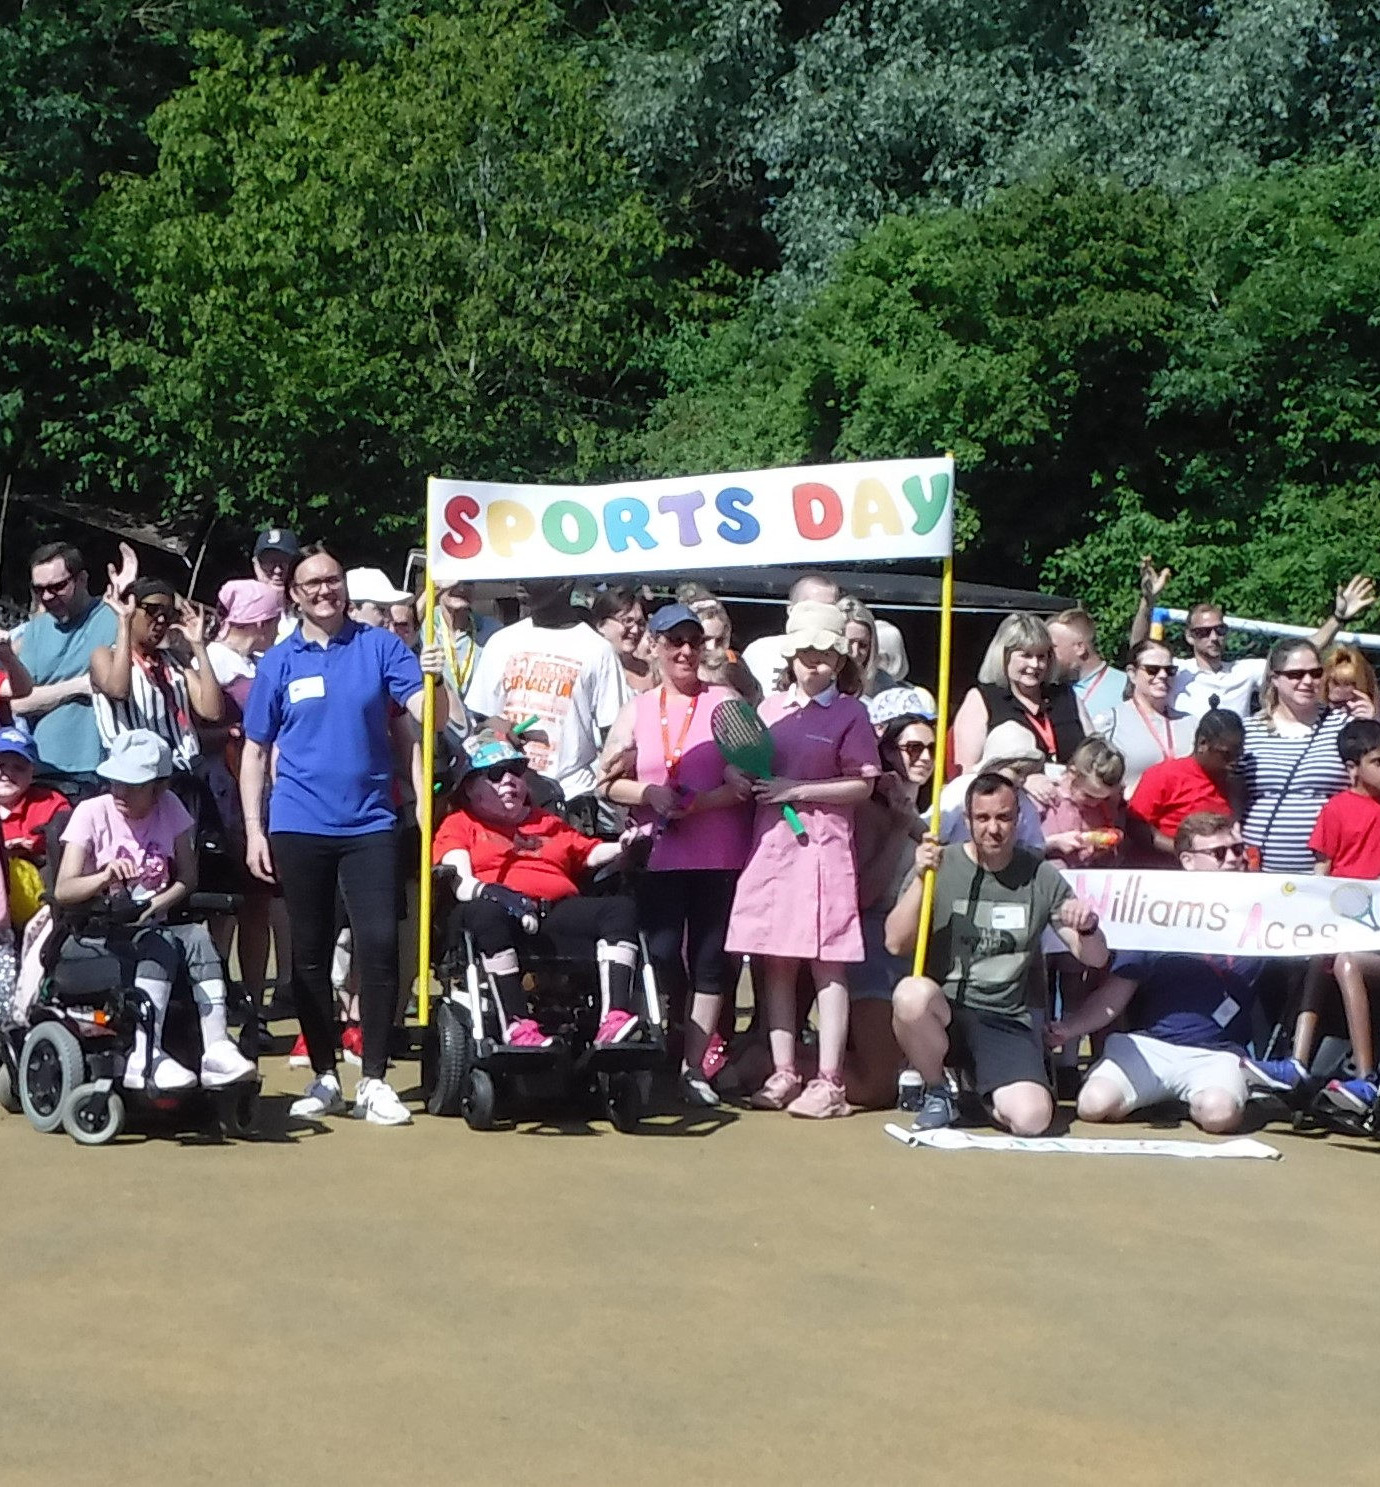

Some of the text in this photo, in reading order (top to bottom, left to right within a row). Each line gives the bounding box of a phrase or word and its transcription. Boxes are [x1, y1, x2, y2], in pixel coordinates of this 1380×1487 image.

[441, 472, 950, 559] SPORTS DAY
[1076, 873, 1339, 951] Williams Aces
